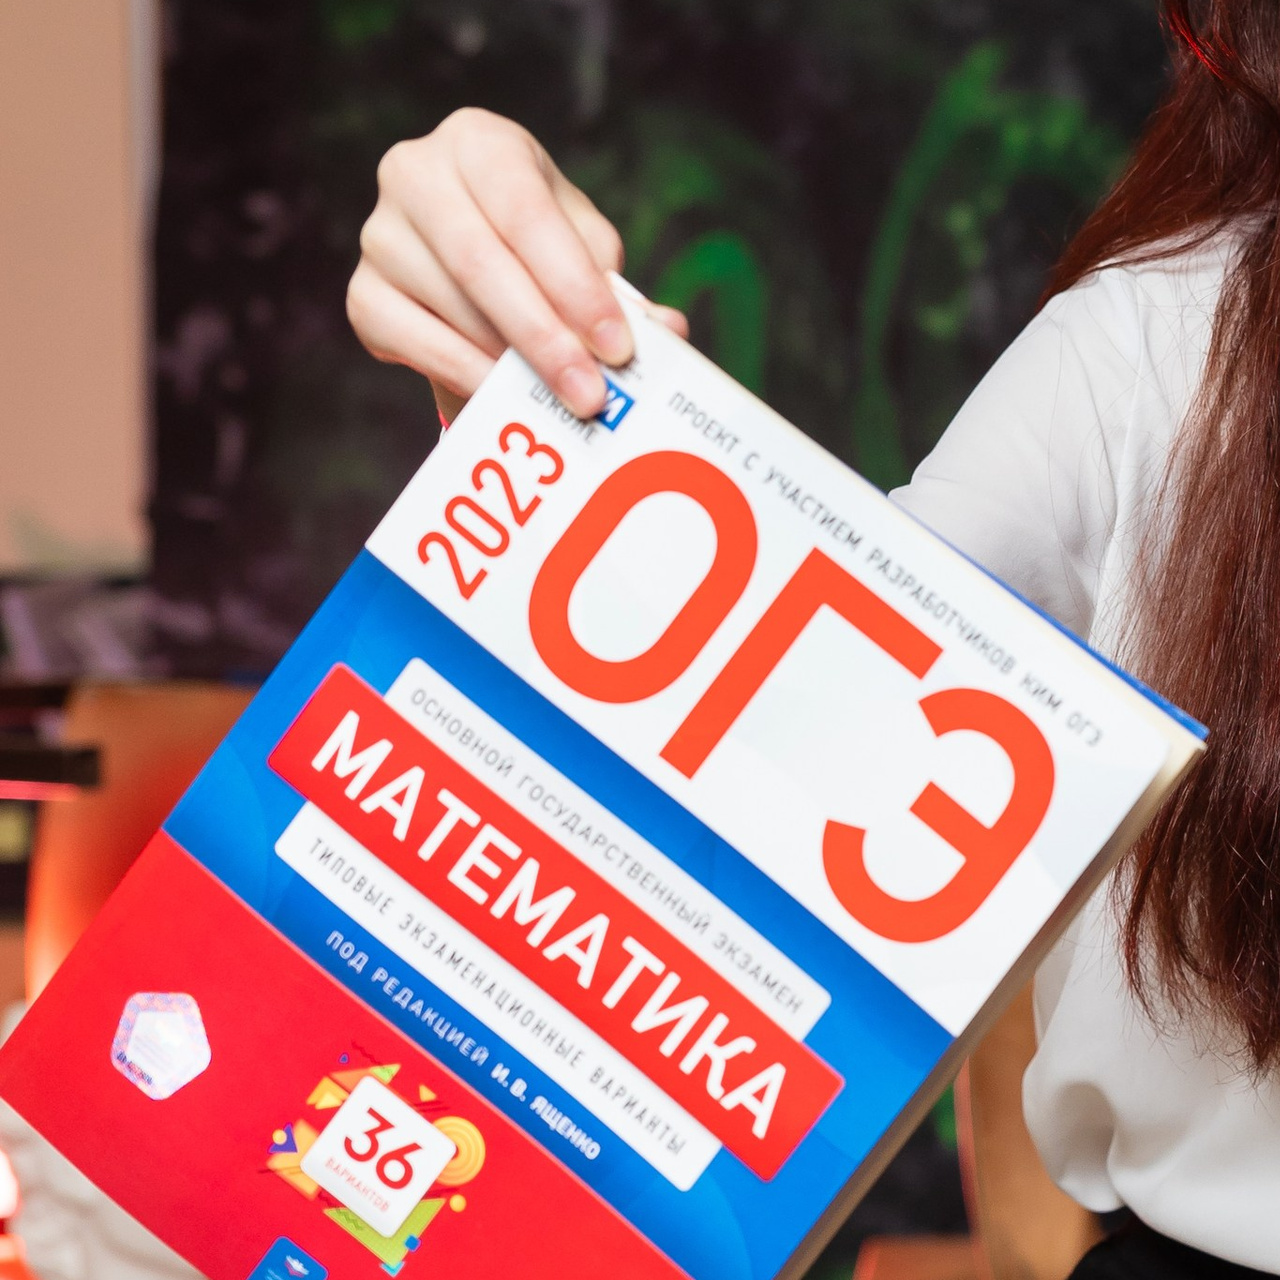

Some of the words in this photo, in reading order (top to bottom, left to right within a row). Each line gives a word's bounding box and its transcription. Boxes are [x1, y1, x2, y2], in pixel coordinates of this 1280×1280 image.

[416, 421, 566, 601] 2023
[669, 392, 741, 453] ПРОЕКТ
[743, 451, 760, 471] С
[763, 467, 863, 551] УЧАСТИЕМ
[866, 546, 1016, 674] РАЗРАБОТЧИКОВ
[1020, 673, 1062, 713] КИМ
[1065, 711, 1103, 746] ОГЭ
[410, 688, 516, 777] ОСНОВНОЙ
[516, 774, 710, 935] ГОСУДАРСТВЕННЫЙ
[712, 931, 803, 1014] ЭКЗАМЕН
[528, 451, 1057, 945] ОГЭ
[309, 709, 788, 1141] МАТЕМАТИКА
[310, 837, 394, 915] ТИПОВЫЕ
[398, 913, 585, 1069] ЭКЗАМЕНАЦИОННЫЕ
[589, 1066, 687, 1156] ВАРИАНТЫ
[326, 930, 369, 974] ПОД
[371, 967, 490, 1066] РЕДАКЦИЕЙ
[530, 1095, 601, 1160] ЯЩЕНКО
[325, 1158, 390, 1212] ВАРИАНТОВ
[344, 1106, 423, 1190] 36
